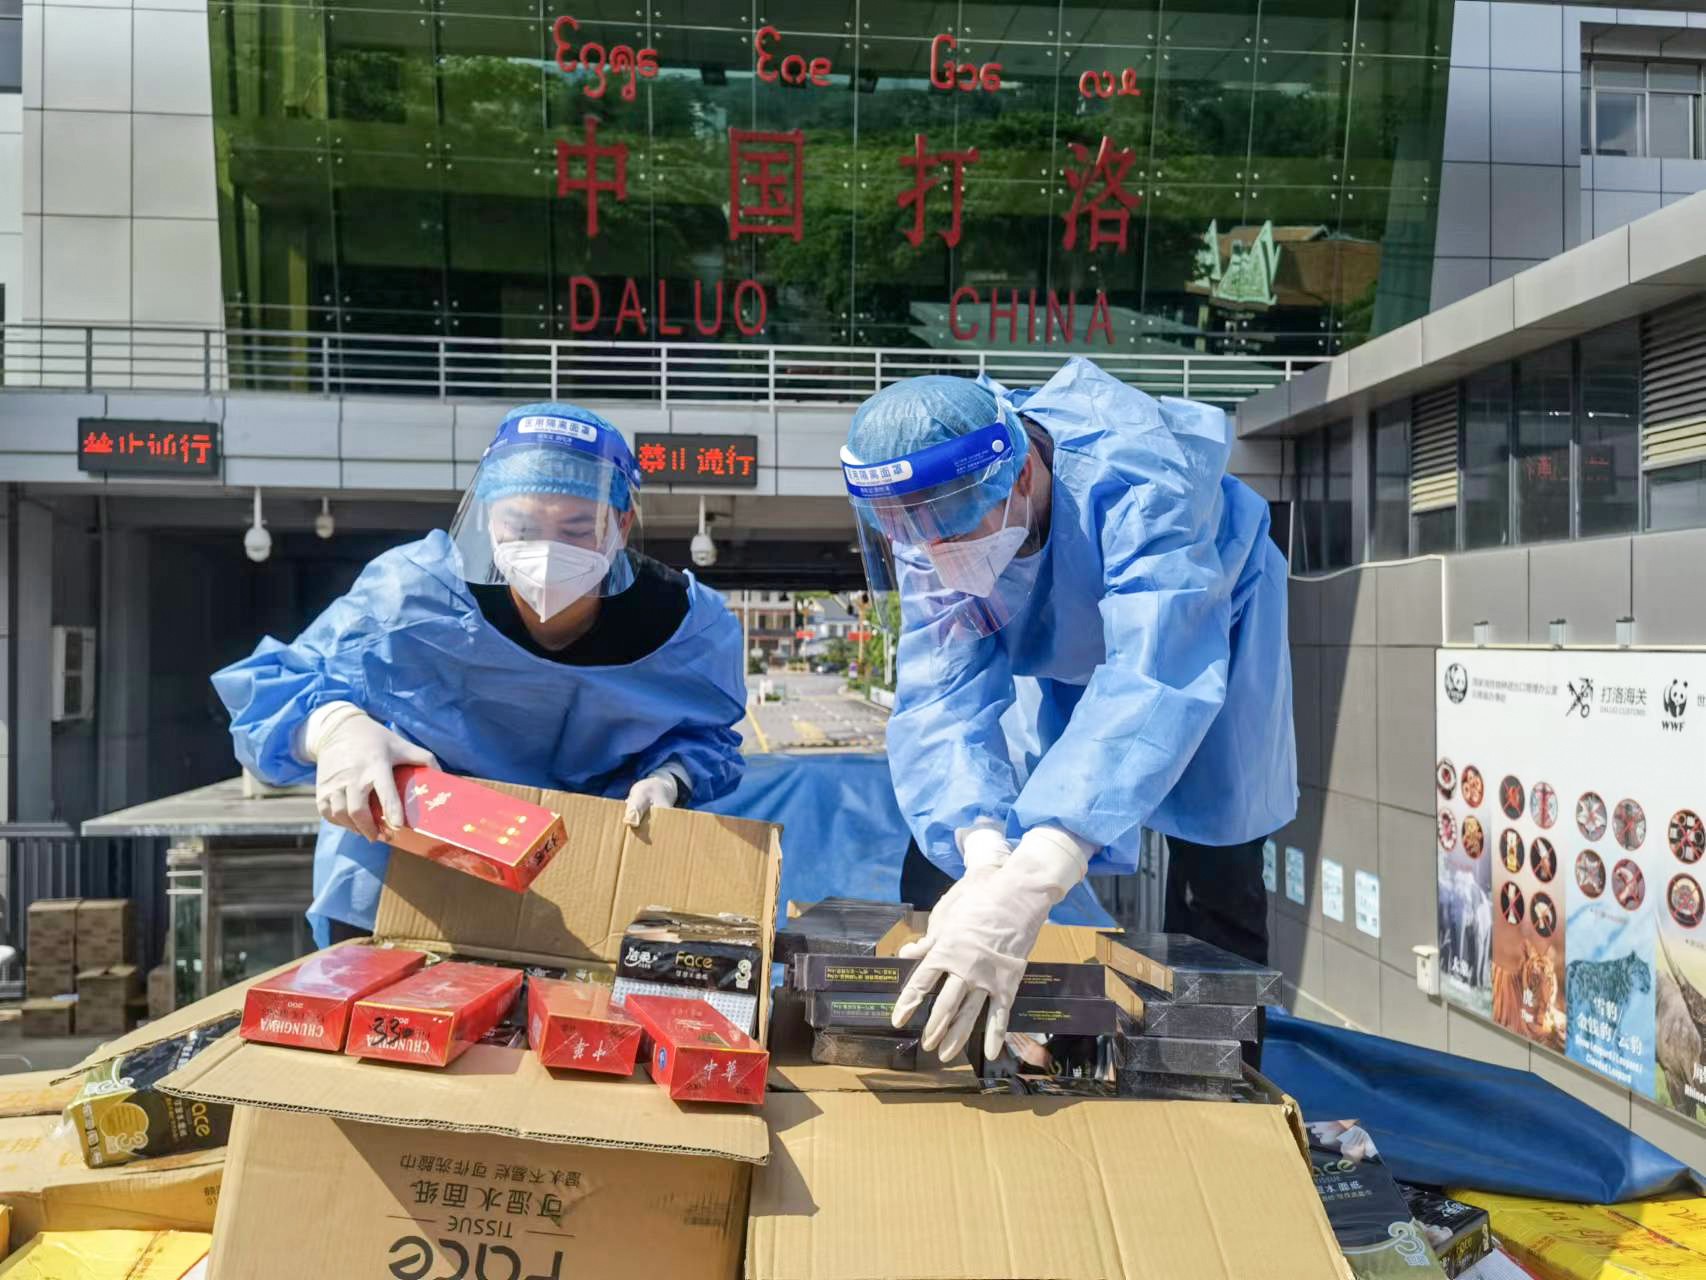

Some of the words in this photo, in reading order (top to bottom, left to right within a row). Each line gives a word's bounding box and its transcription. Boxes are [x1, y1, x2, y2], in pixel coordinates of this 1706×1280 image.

[556, 116, 1141, 253] 中国打洛
[569, 275, 767, 336] DALUO
[948, 286, 1116, 345] CHINA
[1600, 686, 1647, 706] 打洛海关
[1661, 720, 1685, 733] WWF
[675, 951, 713, 968] Face
[260, 1018, 324, 1037] CHUNGHWA
[191, 1102, 210, 1136] ace
[399, 1152, 488, 1177] 可作洗脸巾
[494, 1163, 583, 1188] 湿水不易烂
[410, 1179, 562, 1219] 可湿水面纸
[447, 1215, 513, 1239] TISSUE
